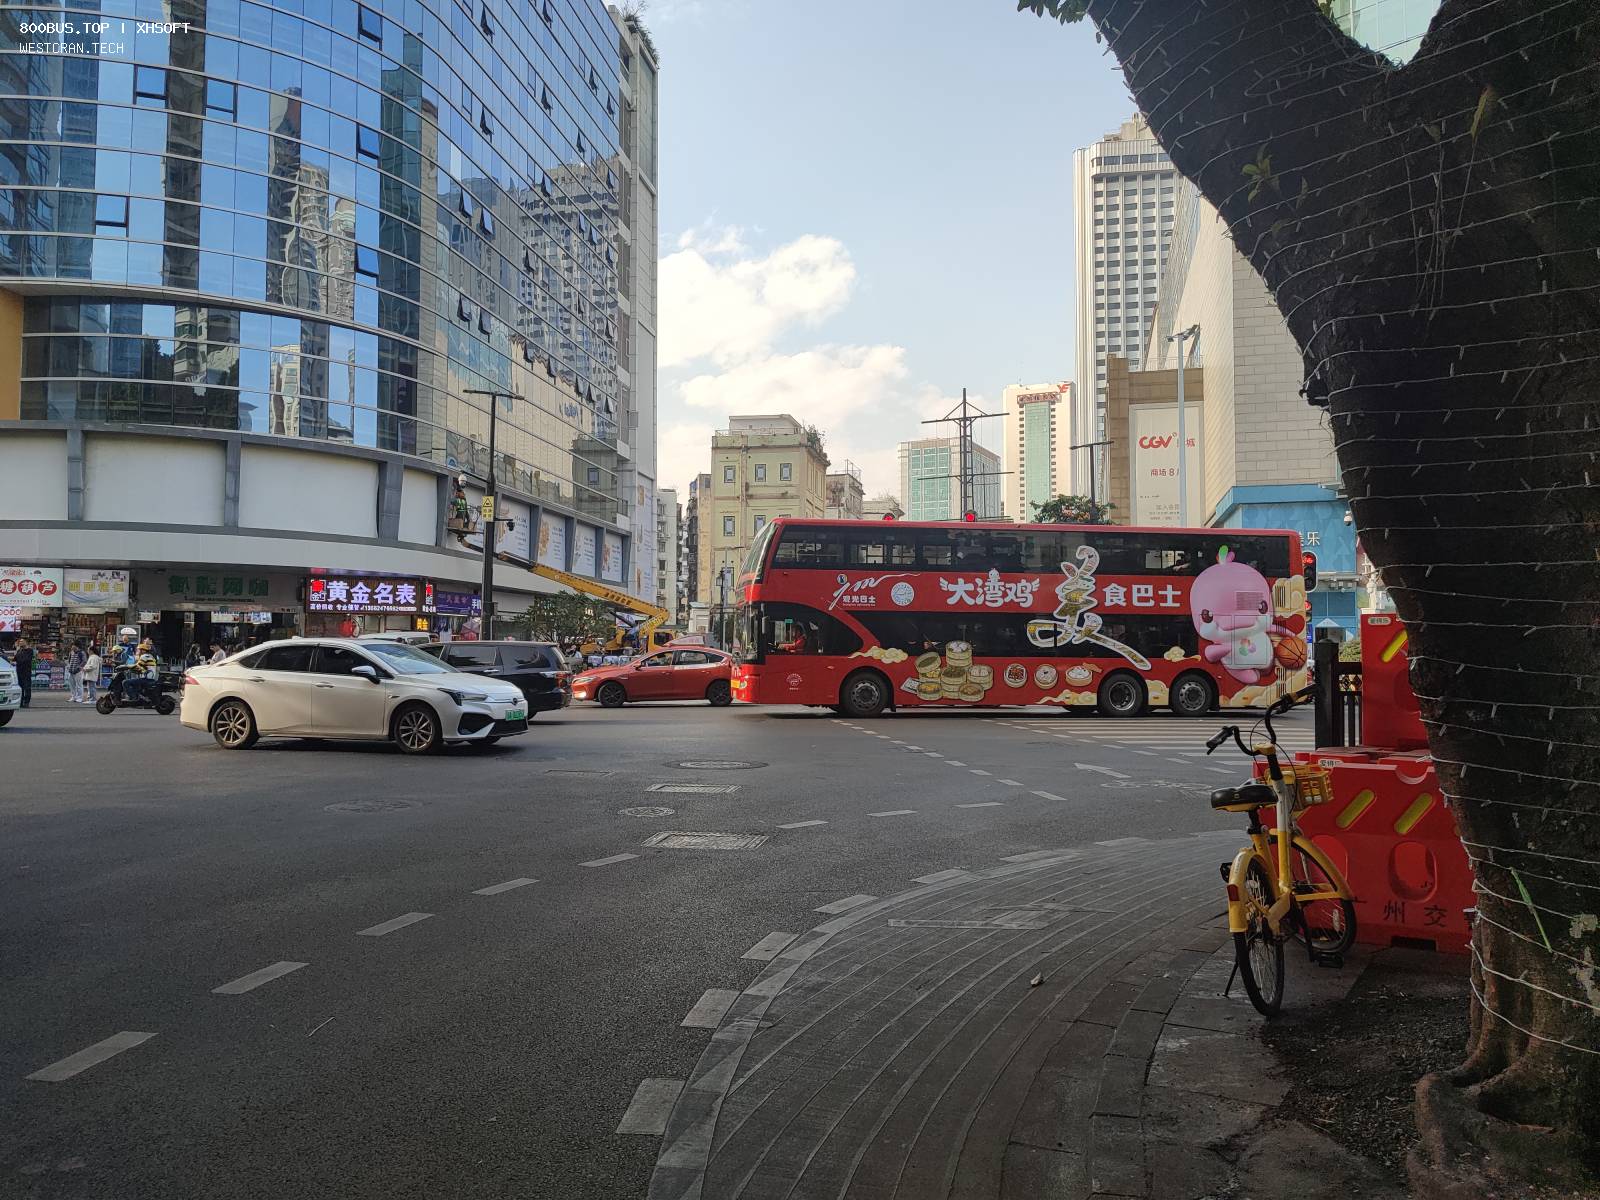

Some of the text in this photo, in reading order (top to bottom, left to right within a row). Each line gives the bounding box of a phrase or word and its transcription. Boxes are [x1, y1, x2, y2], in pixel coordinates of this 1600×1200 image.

[1139, 436, 1172, 449] CGV
[327, 580, 416, 604] 黄金名表
[940, 568, 1040, 608] 大湾鸡
